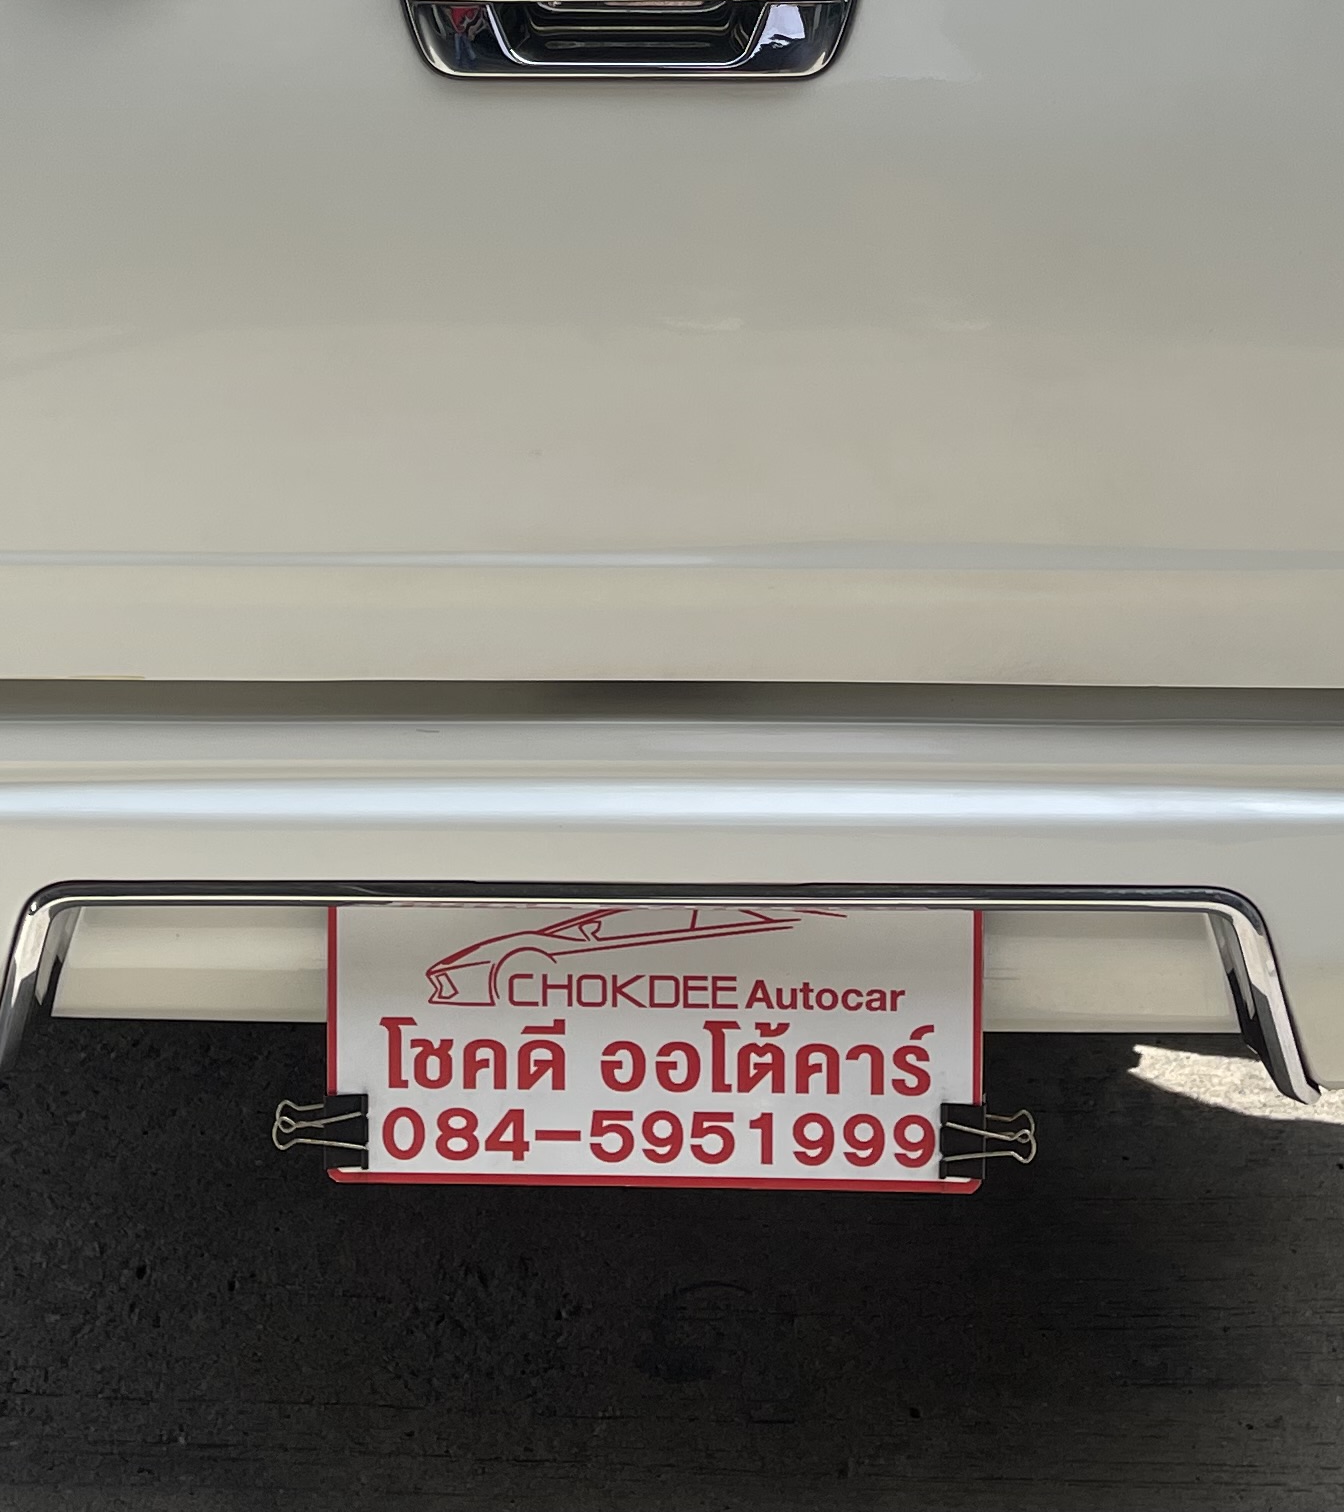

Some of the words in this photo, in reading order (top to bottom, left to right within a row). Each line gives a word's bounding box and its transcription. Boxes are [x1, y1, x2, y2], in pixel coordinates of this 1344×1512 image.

[507, 973, 739, 1010] CHOKDEE
[744, 981, 906, 1013] Autocar
[378, 1014, 567, 1091] โชคดี
[599, 1019, 937, 1097] ออโต้คาร์
[381, 1105, 937, 1169] 084-5951999
